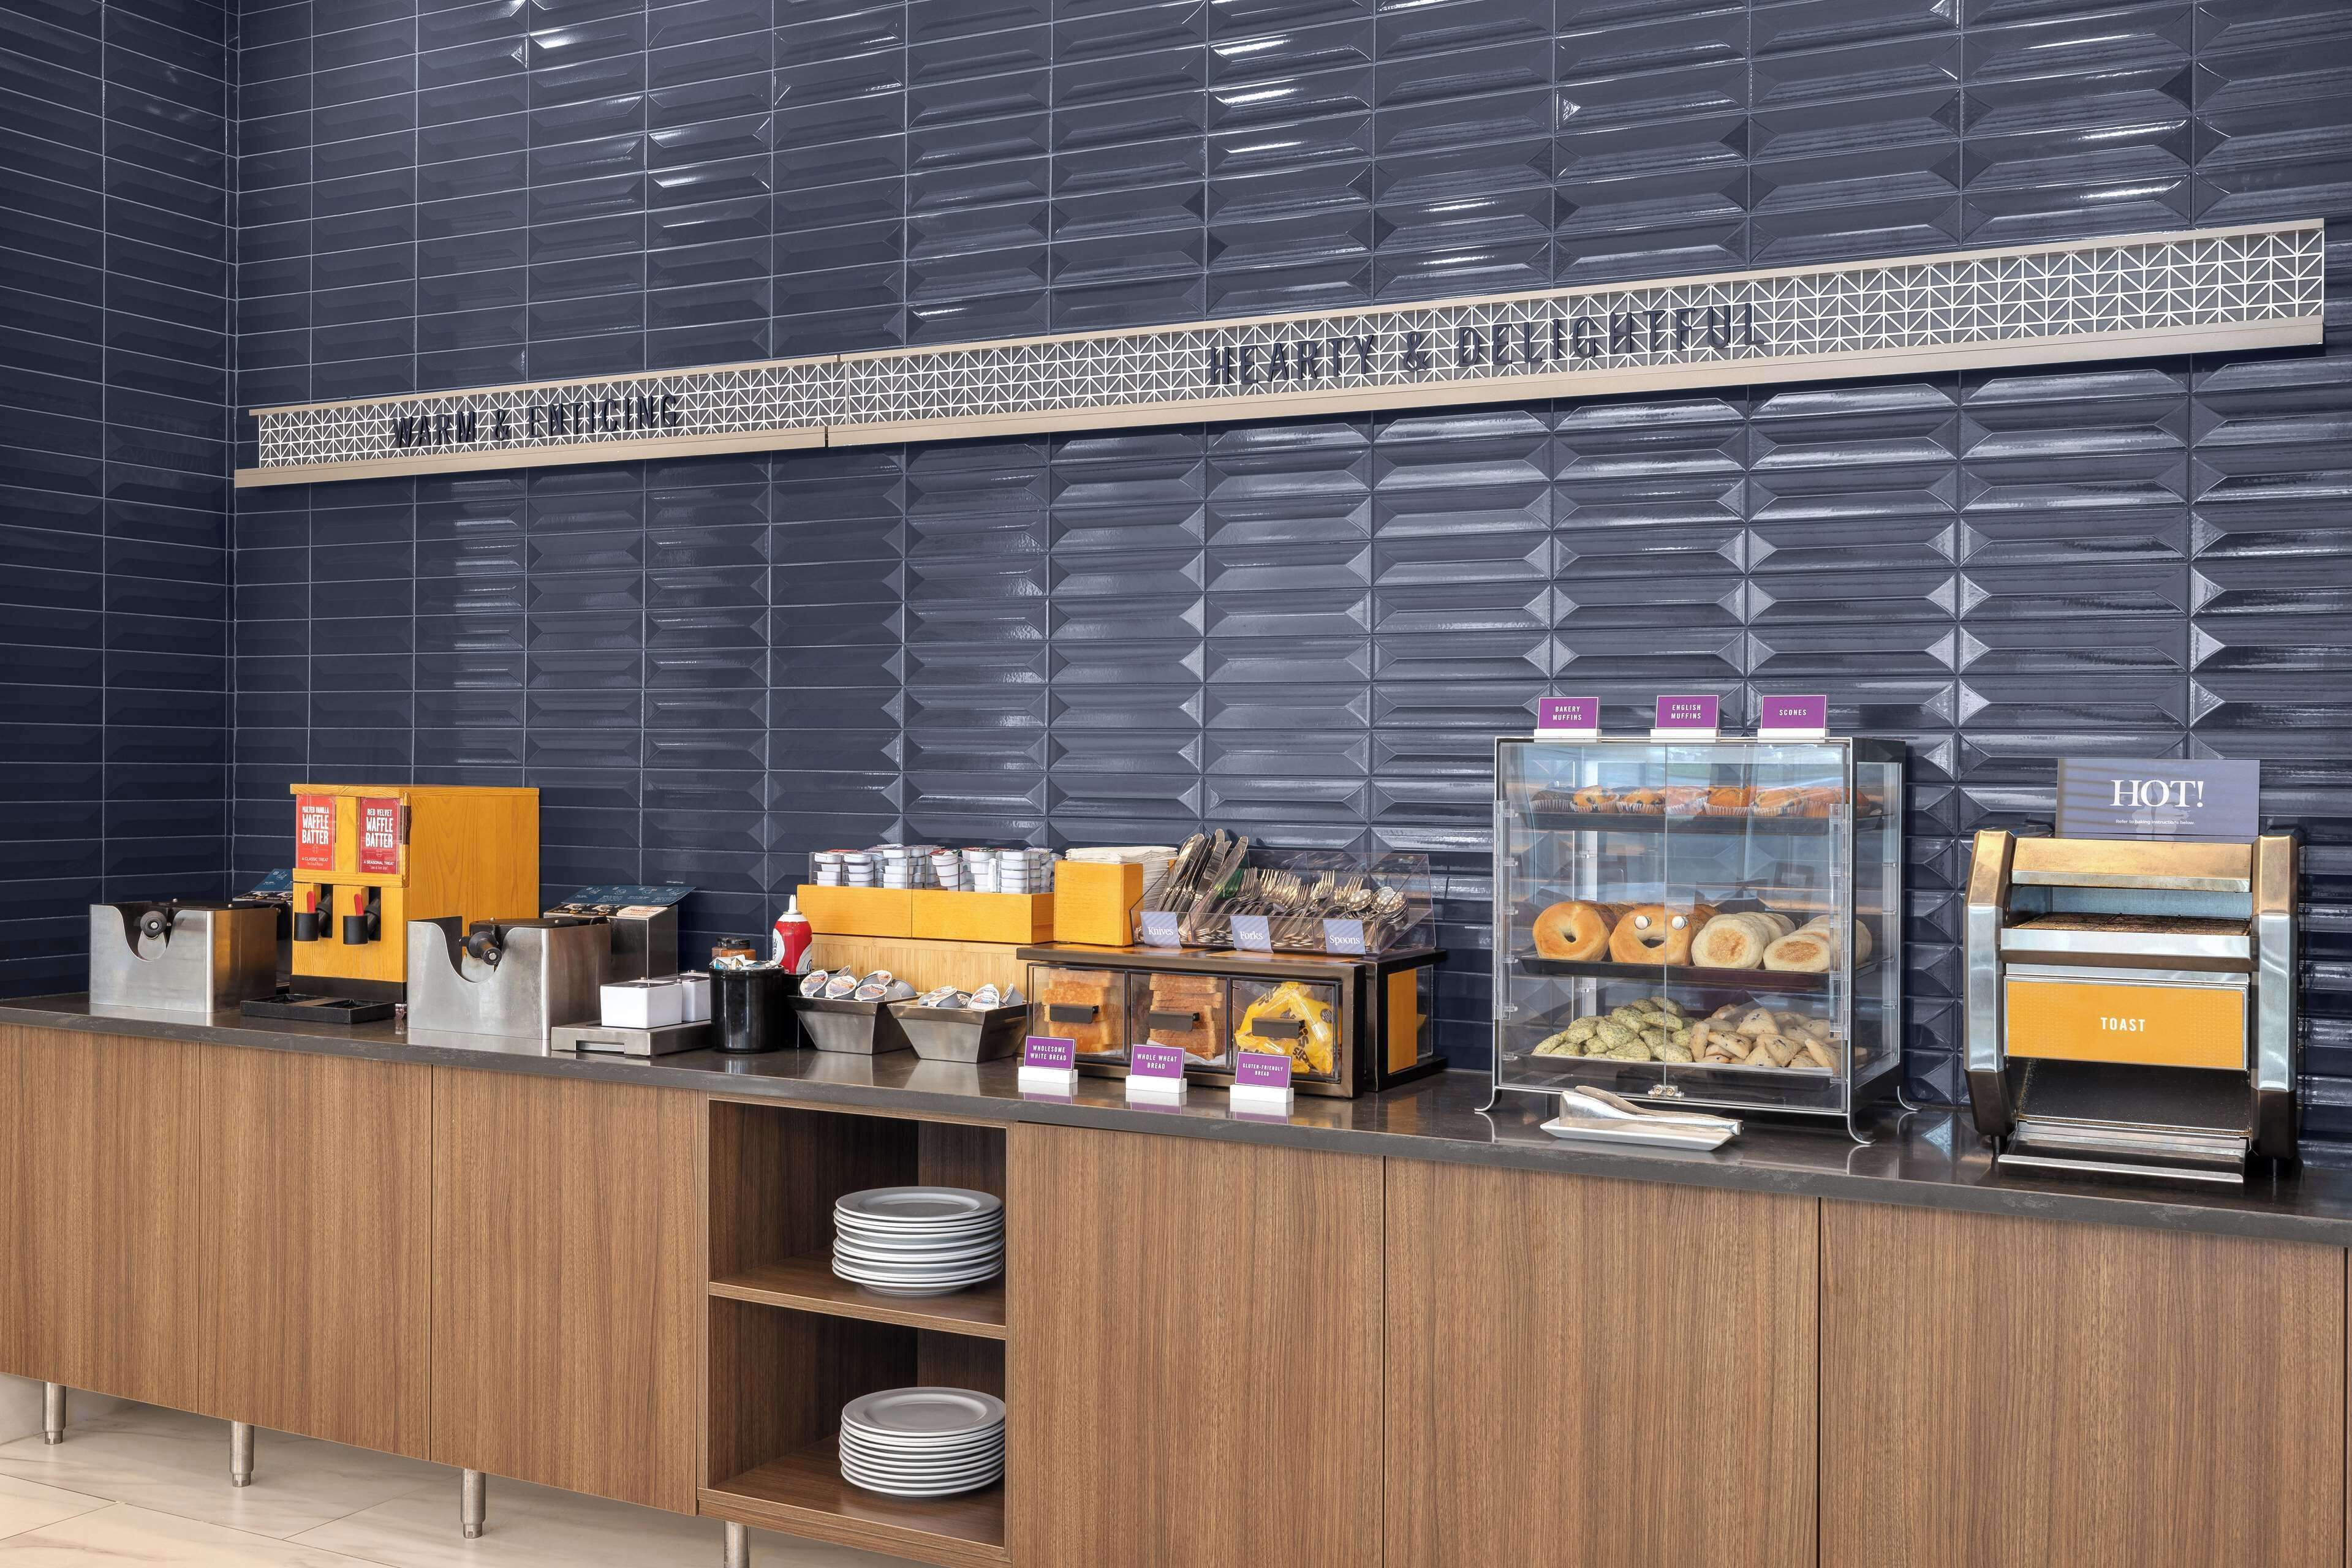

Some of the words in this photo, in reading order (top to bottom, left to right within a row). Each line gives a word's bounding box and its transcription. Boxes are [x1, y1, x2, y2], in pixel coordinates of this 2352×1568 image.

[1210, 334, 1374, 385] HEARTY
[1403, 331, 1428, 372] &
[1458, 303, 1764, 367] DELIGHTFUL
[393, 410, 476, 448] WARM
[493, 409, 509, 441] &
[528, 394, 676, 439] ENTICING
[2110, 780, 2204, 808] HOT!
[302, 813, 330, 829] WAFFLE
[377, 809, 393, 817] VELVET
[366, 816, 394, 833] WAFFLE
[301, 829, 329, 845] BATTER
[365, 832, 394, 849] BATTER
[1148, 927, 1174, 937] Knives
[1239, 930, 1264, 941] Forks
[1329, 935, 1361, 946] Spoons
[2100, 1017, 2146, 1032] TOAST
[1242, 1063, 1284, 1071] GLUTEN-FRIENDLY
